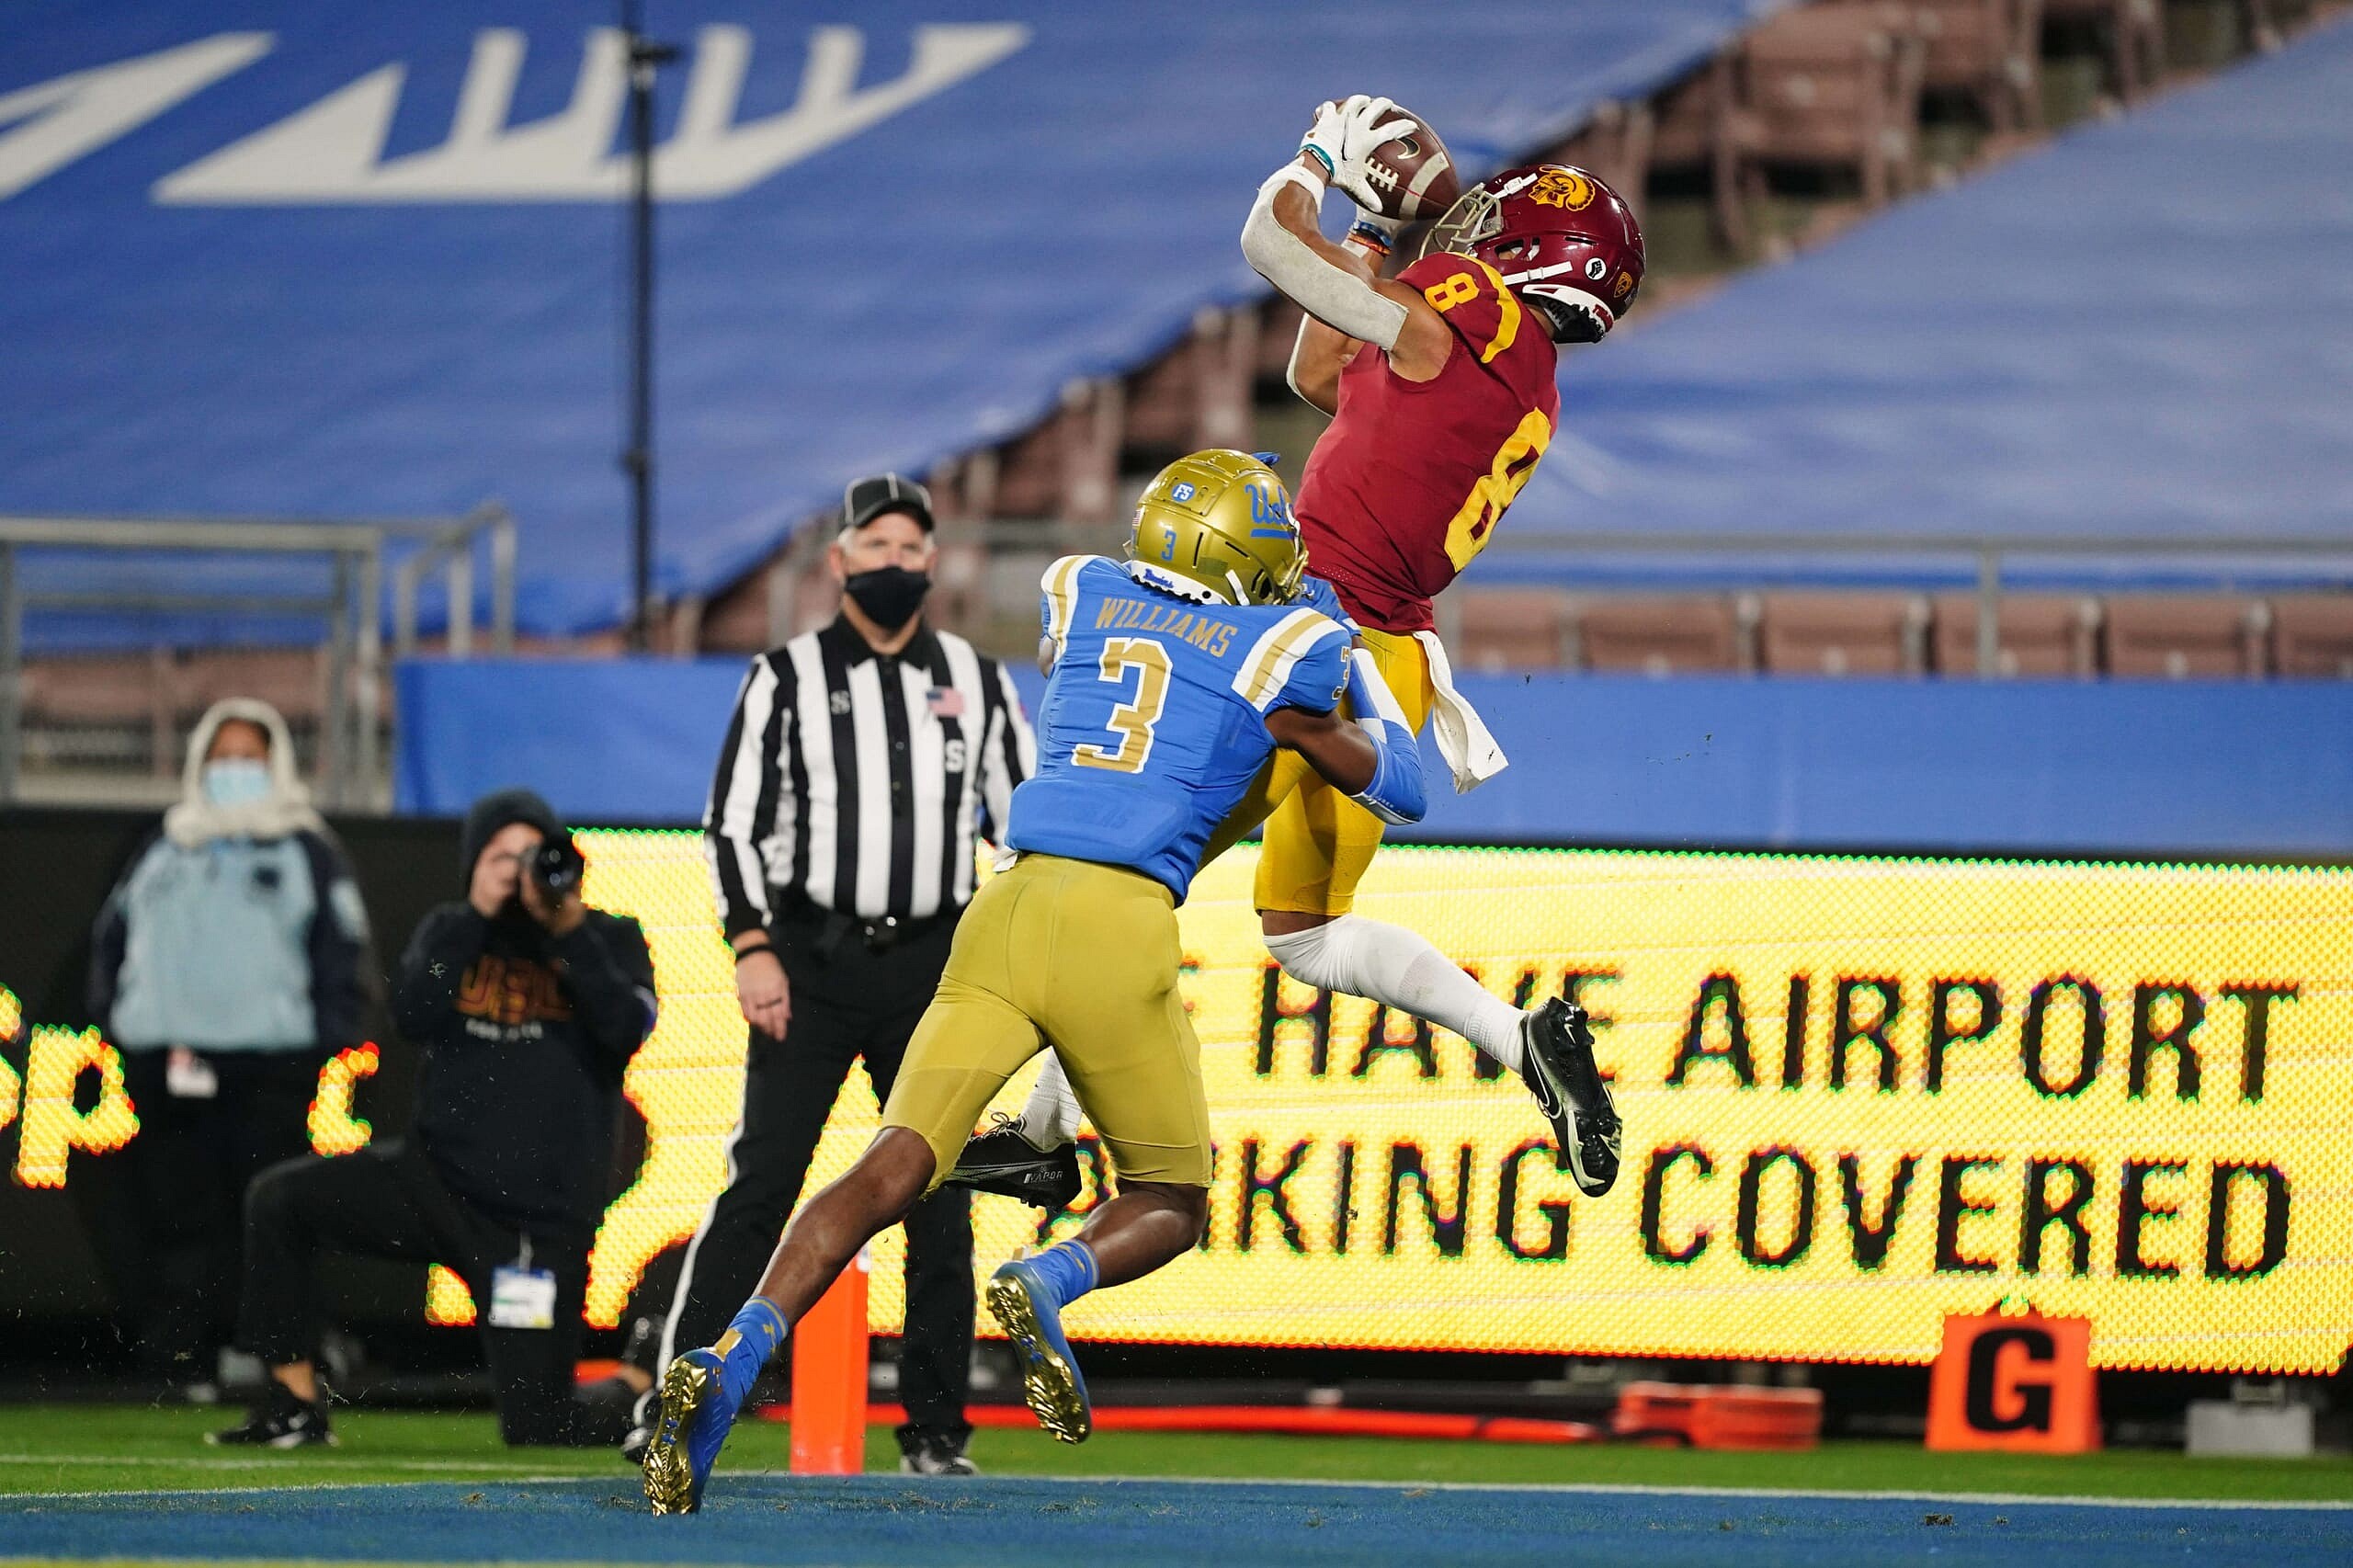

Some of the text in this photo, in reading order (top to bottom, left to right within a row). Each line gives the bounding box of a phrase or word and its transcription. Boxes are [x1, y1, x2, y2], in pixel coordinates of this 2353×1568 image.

[1425, 272, 1480, 313] 8
[1443, 406, 1552, 573] 8
[1161, 529, 1177, 562] 3
[1095, 597, 1239, 658] WILLIAMS
[945, 738, 966, 774] S
[1070, 637, 1173, 774] 3
[1665, 972, 2300, 1106] AIRPORT
[1639, 1144, 2291, 1283] COVERED
[1965, 1326, 2055, 1433] G
